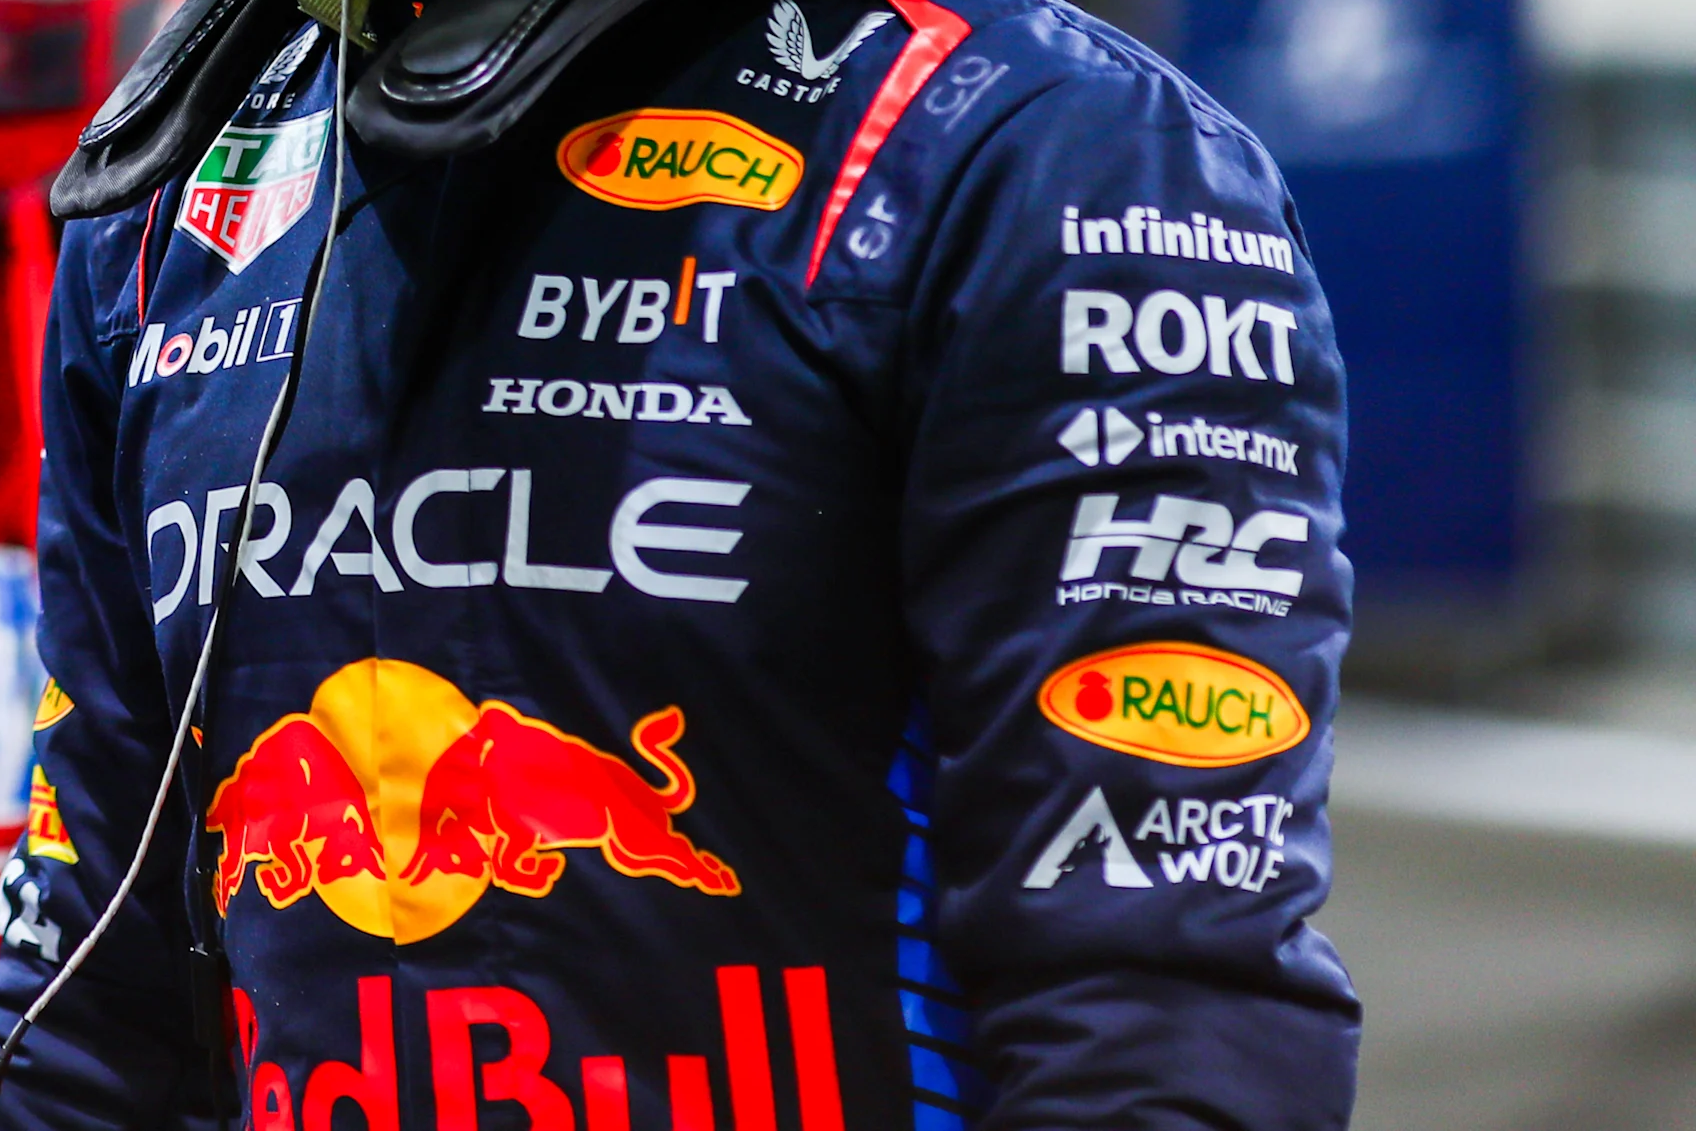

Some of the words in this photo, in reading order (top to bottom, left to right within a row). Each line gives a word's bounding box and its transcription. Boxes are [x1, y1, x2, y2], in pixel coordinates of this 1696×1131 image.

[736, 68, 842, 103] CASTOE
[219, 126, 323, 181] TAG
[624, 136, 784, 197] RAUCH
[192, 178, 314, 257] HEUER
[1062, 205, 1295, 275] infinitum
[516, 256, 737, 343] BYBIT
[129, 306, 262, 388] Mobil
[1061, 288, 1298, 386] ROKT
[482, 378, 752, 426] HONDA
[1146, 411, 1299, 476] inter.mx
[146, 467, 752, 626] ORACLE
[1059, 493, 1309, 597] HRC
[1180, 588, 1293, 618] RACING
[1122, 676, 1275, 738] RAUCH
[1134, 794, 1294, 847] ARCTIC
[1158, 839, 1285, 893] WOLF
